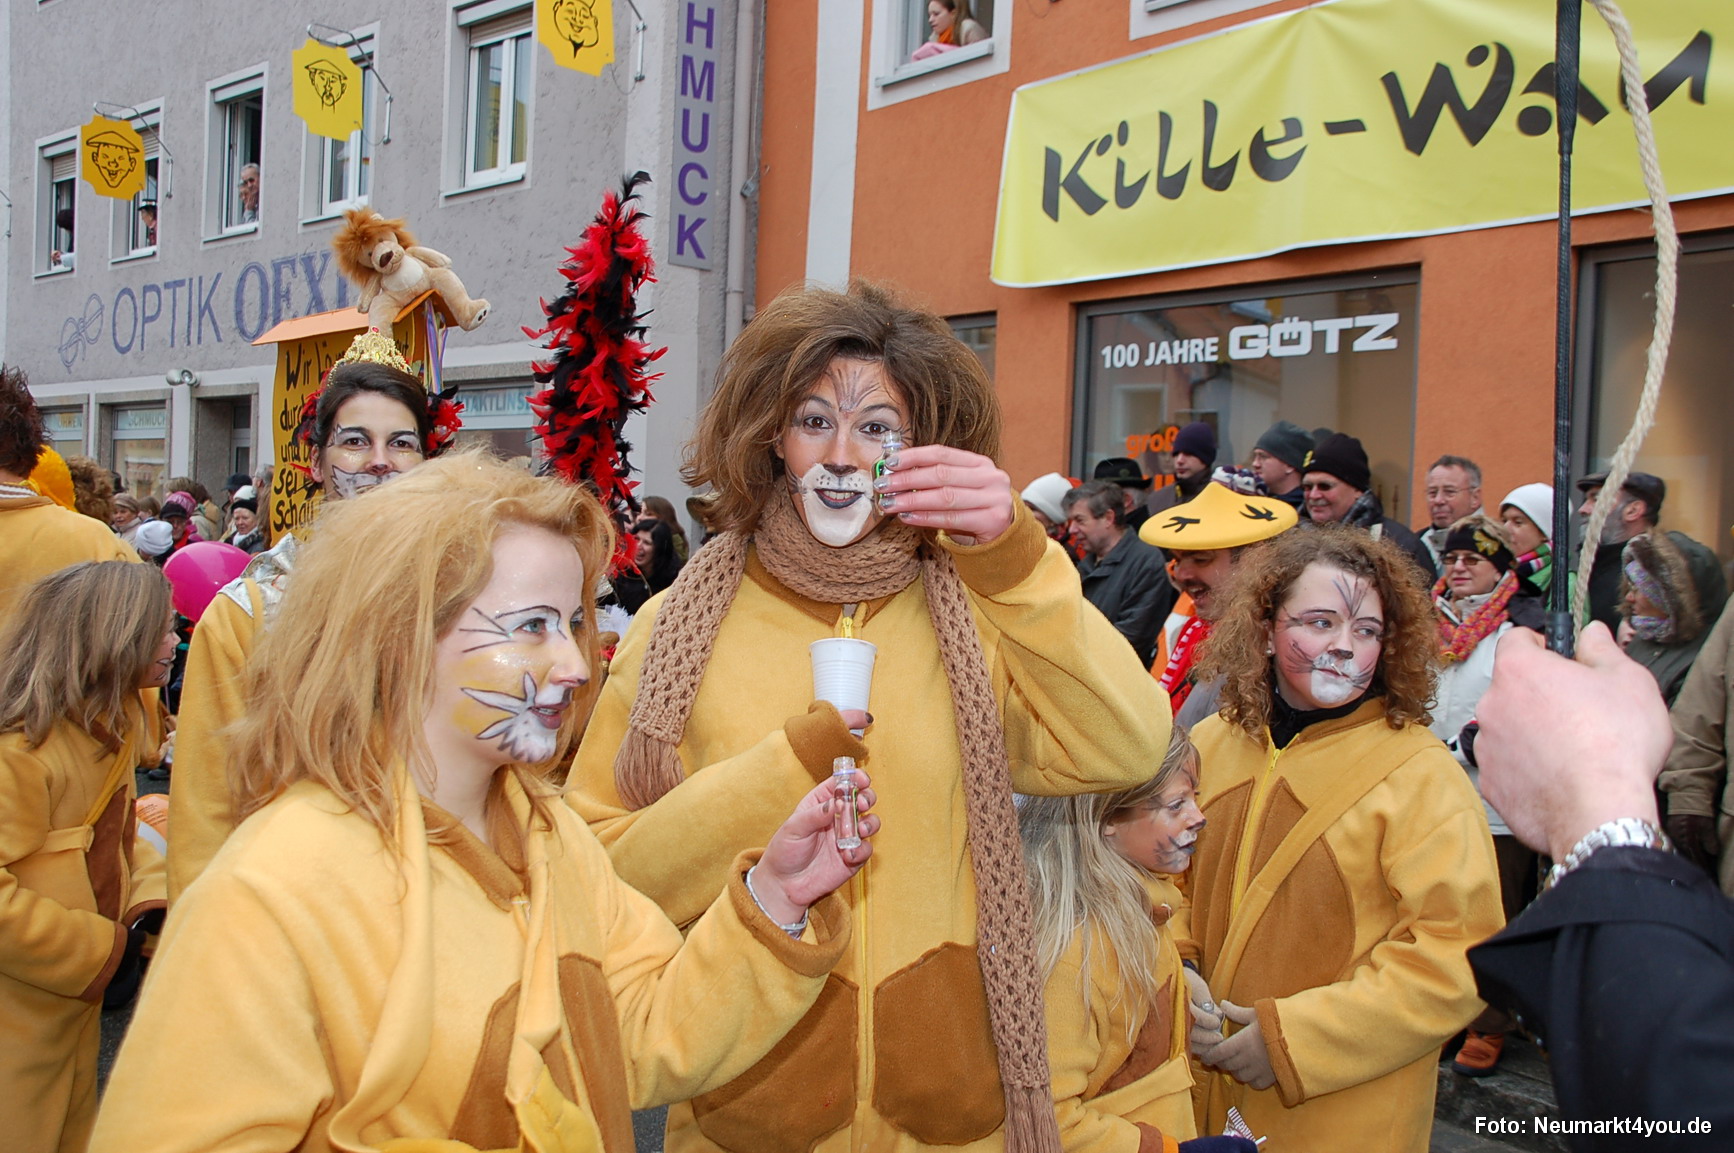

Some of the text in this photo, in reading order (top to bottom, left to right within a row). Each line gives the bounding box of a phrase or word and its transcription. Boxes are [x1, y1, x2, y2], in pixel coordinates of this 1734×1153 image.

[111, 271, 224, 355] OPTIK
[1101, 312, 1399, 369] 100 JAHRE GÖTZ
[285, 342, 312, 391] Wir
